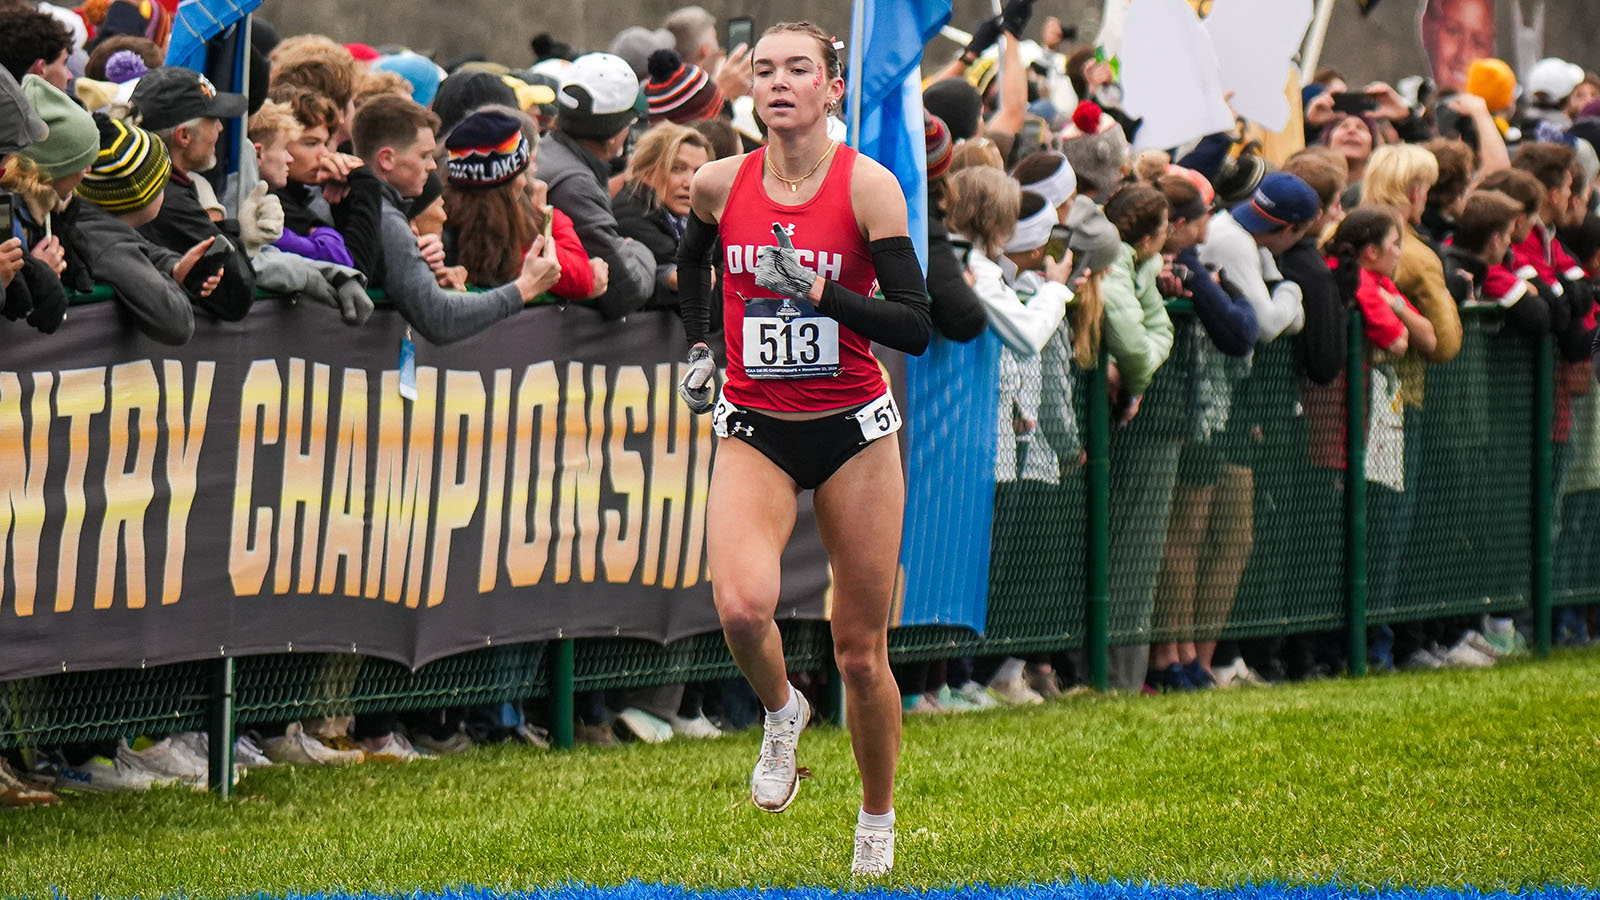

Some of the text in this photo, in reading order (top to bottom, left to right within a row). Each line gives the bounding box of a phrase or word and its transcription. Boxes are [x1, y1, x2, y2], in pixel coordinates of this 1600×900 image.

[727, 244, 842, 281] DUCH
[760, 323, 820, 365] 513
[228, 357, 723, 608] CHAMPIONSHI
